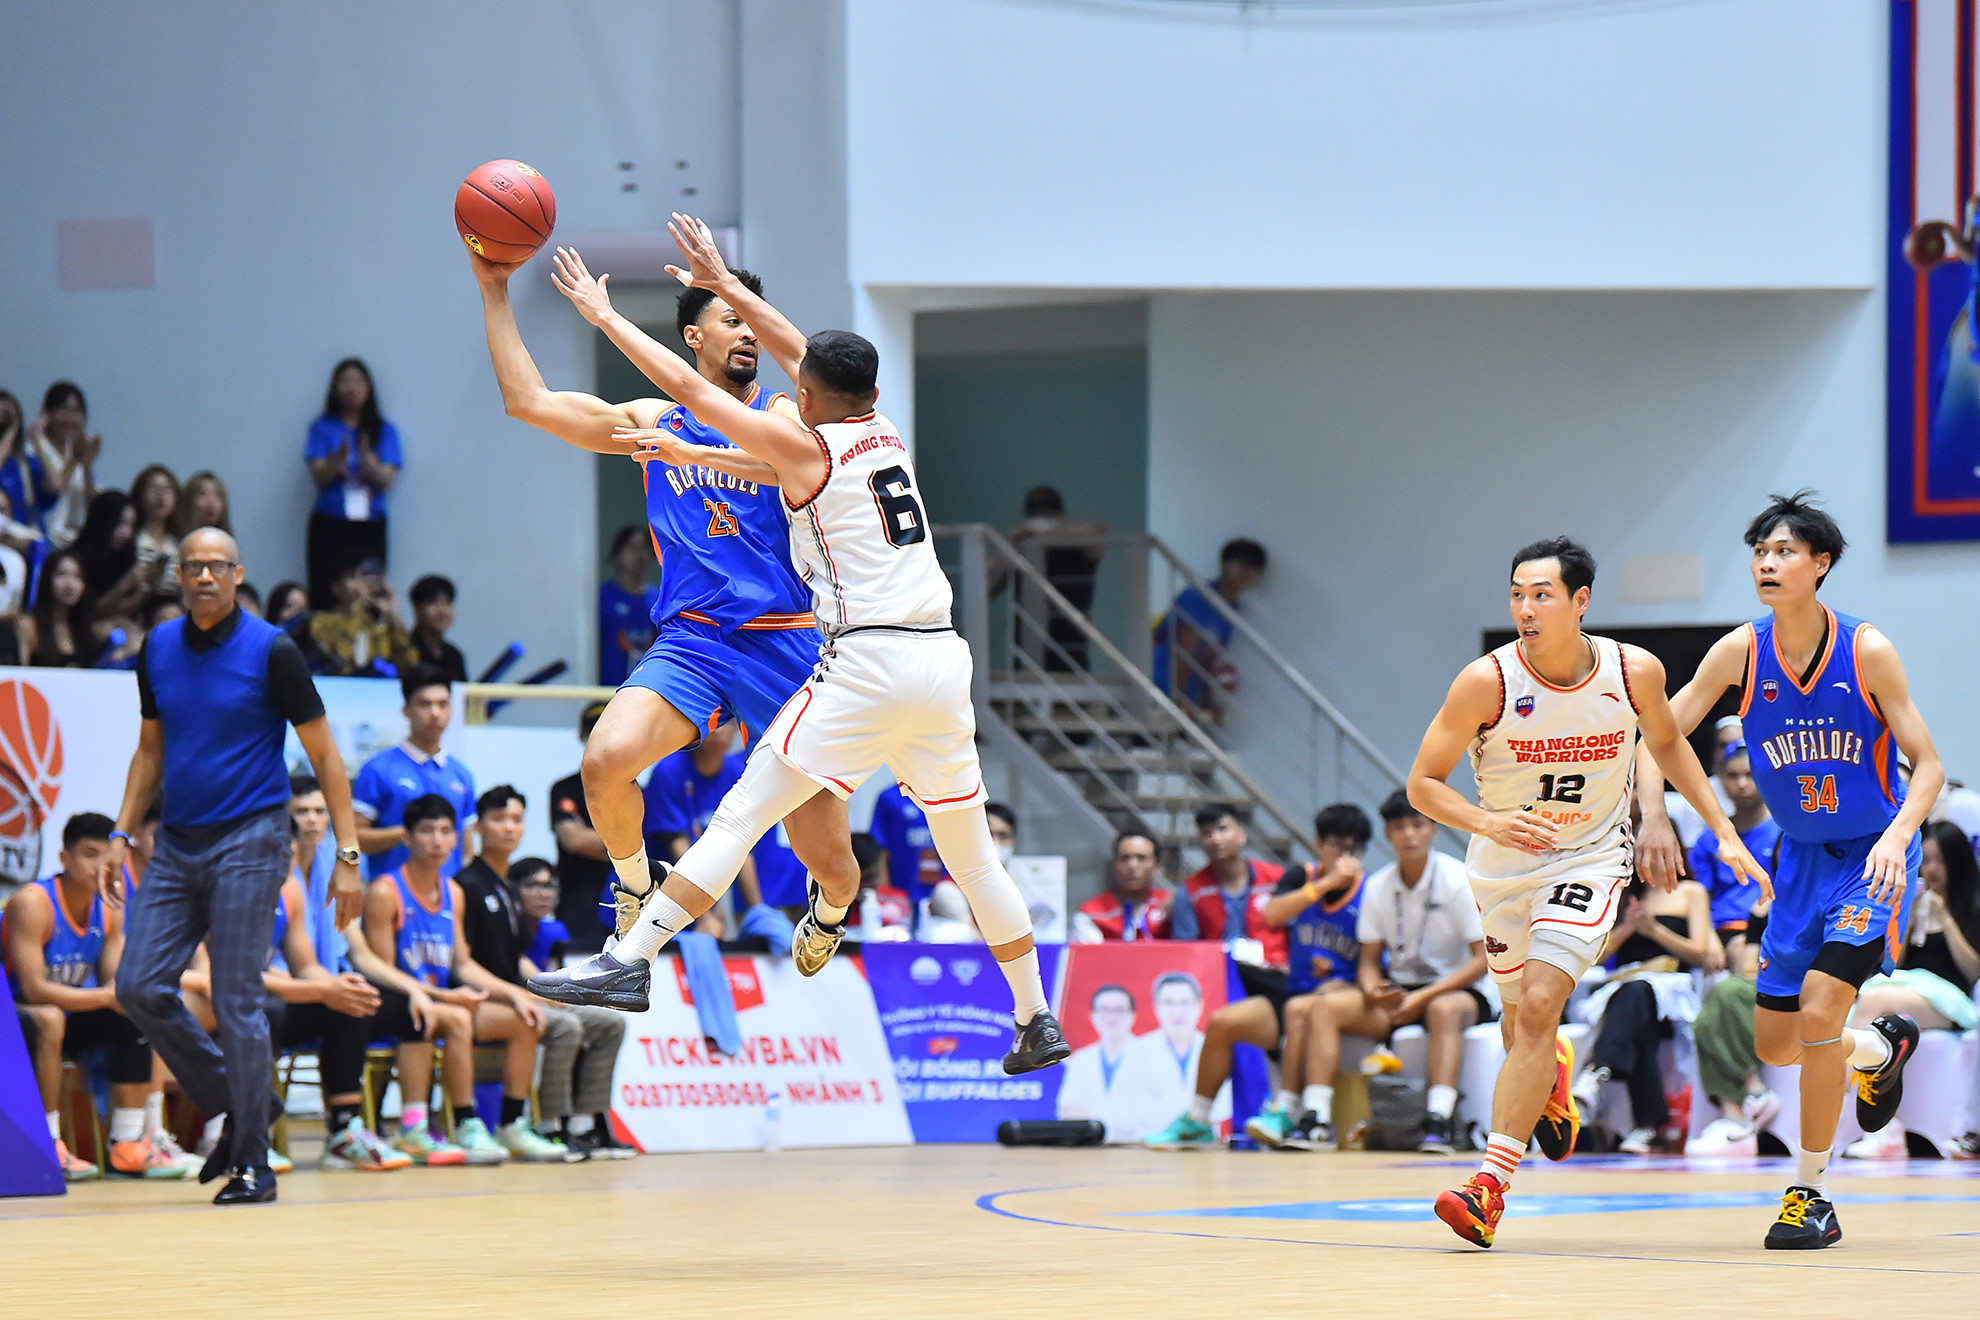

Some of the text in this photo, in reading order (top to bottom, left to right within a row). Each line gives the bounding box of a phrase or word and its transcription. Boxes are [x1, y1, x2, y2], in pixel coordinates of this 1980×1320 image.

[703, 498, 740, 538] 25
[867, 465, 926, 550] 6
[1507, 730, 1626, 751] THANGLONG
[1515, 746, 1618, 764] WARRIORS
[1761, 729, 1863, 771] BUFFALOES
[1536, 773, 1586, 804] 12
[1796, 774, 1839, 813] 34
[1547, 883, 1594, 913] 12
[1834, 904, 1873, 935] 34
[870, 1081, 884, 1104] 3
